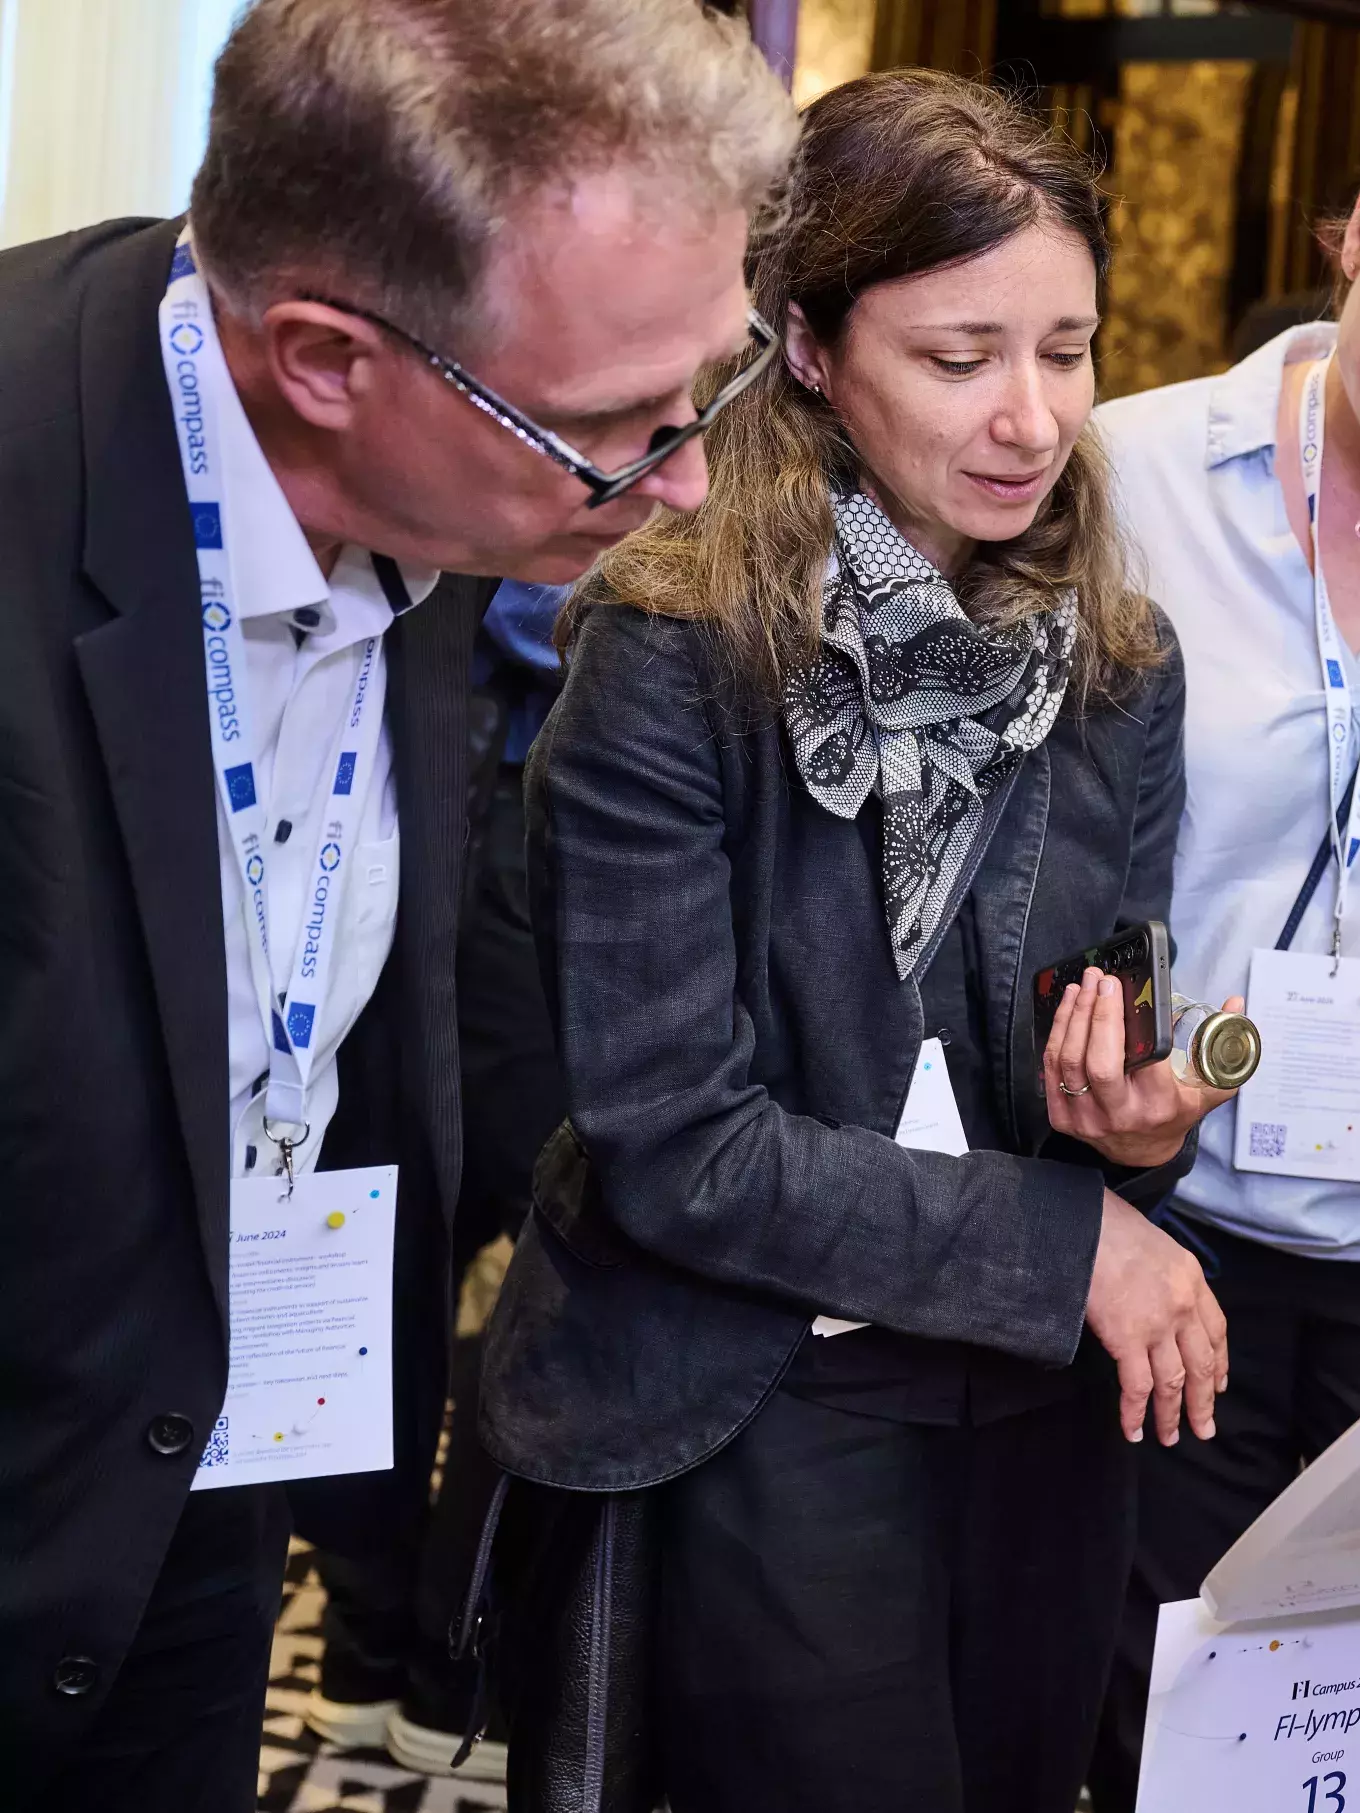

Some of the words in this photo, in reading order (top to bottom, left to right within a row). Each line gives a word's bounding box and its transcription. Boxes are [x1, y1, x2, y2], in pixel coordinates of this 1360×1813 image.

[177, 361, 209, 475] compass
[207, 636, 241, 742] compass
[351, 639, 376, 728] ompass
[301, 875, 330, 979] compass
[236, 1232, 259, 1243] June
[261, 1230, 287, 1241] 2024
[1312, 1680, 1356, 1696] Campus
[1311, 1749, 1345, 1764] Group
[1302, 1770, 1347, 1813] 13
